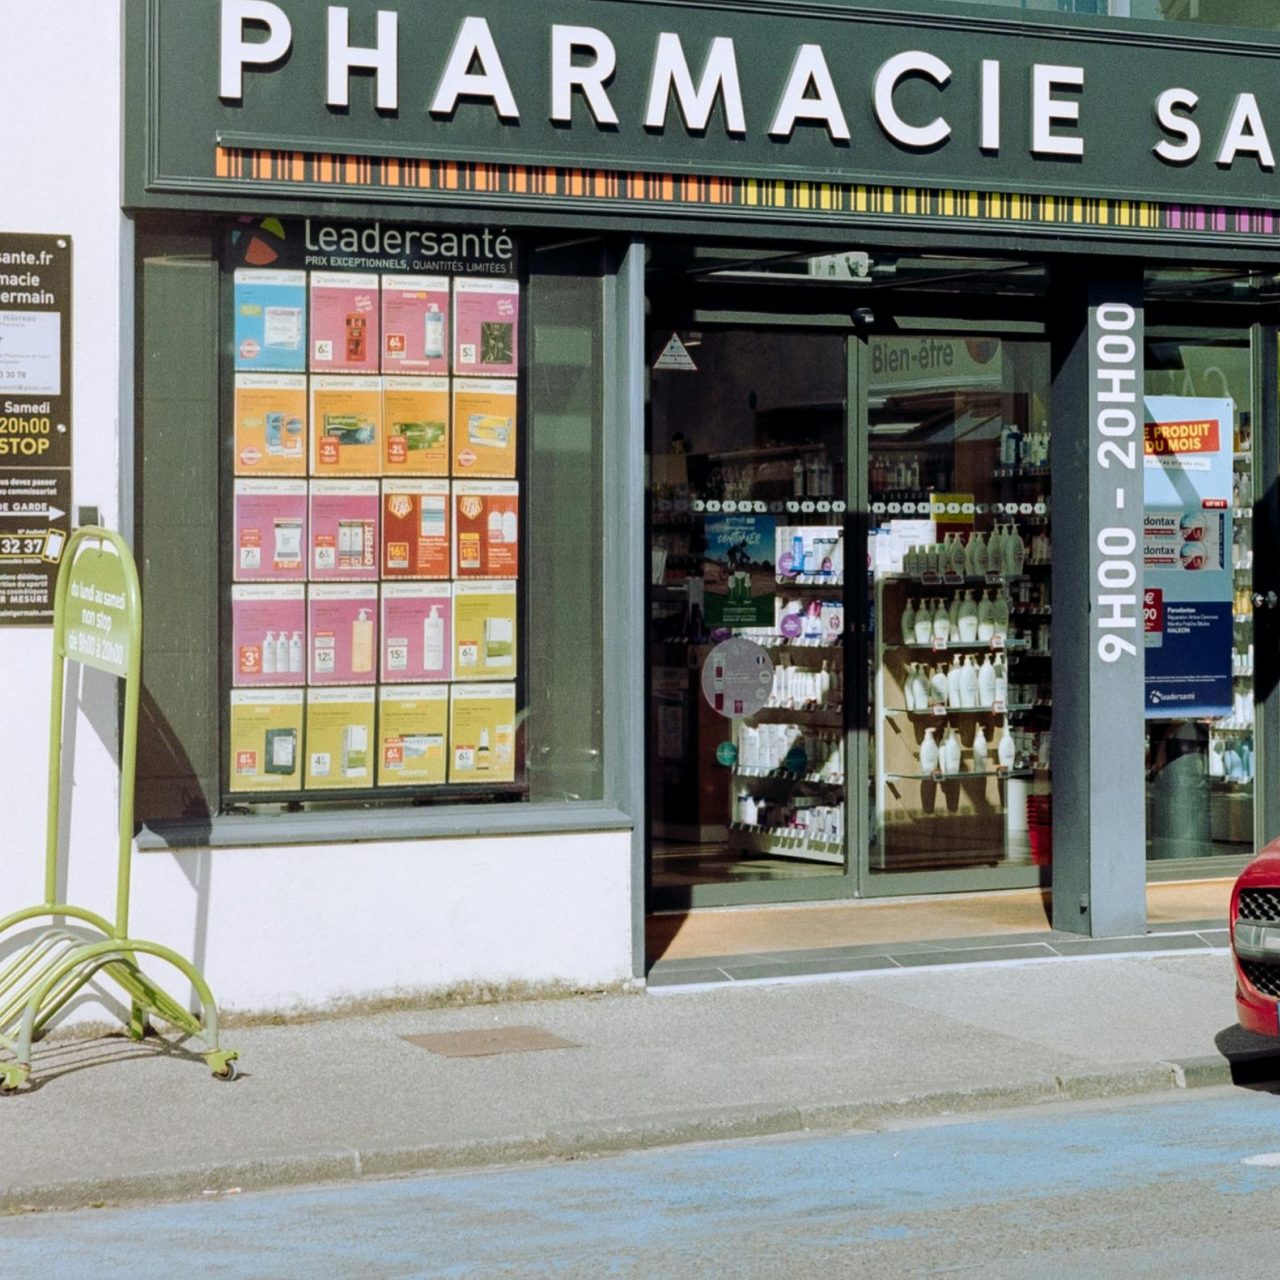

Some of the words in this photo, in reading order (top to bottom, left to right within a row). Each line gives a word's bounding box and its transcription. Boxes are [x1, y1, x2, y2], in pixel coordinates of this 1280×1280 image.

[305, 219, 513, 259] leadersanté
[305, 255, 328, 266] PRIX
[330, 256, 410, 270] EXCEPTIONNELS,
[412, 259, 464, 272] QUANTITÉS
[466, 261, 507, 273] LIMITÉES
[872, 338, 954, 374] Bien-être
[1096, 302, 1137, 470] 20H00
[4, 401, 51, 414] Samedi
[0, 417, 50, 434] 20h00
[1154, 423, 1210, 439] PRODUIT
[0, 437, 50, 455] STOP
[1145, 441, 1164, 453] DU
[1168, 438, 1201, 451] MOIS
[8, 487, 57, 495] commissariat
[10, 478, 31, 486] devez
[32, 479, 57, 487] passer
[12, 502, 48, 511] GARDE
[1, 538, 21, 554] 32
[23, 538, 43, 553] 37
[364, 526, 375, 565] OFFERT
[10, 595, 48, 603] MESURE
[104, 592, 126, 610] samedi
[1097, 527, 1137, 663] 9H00
[81, 609, 96, 626] non
[96, 610, 112, 634] stop
